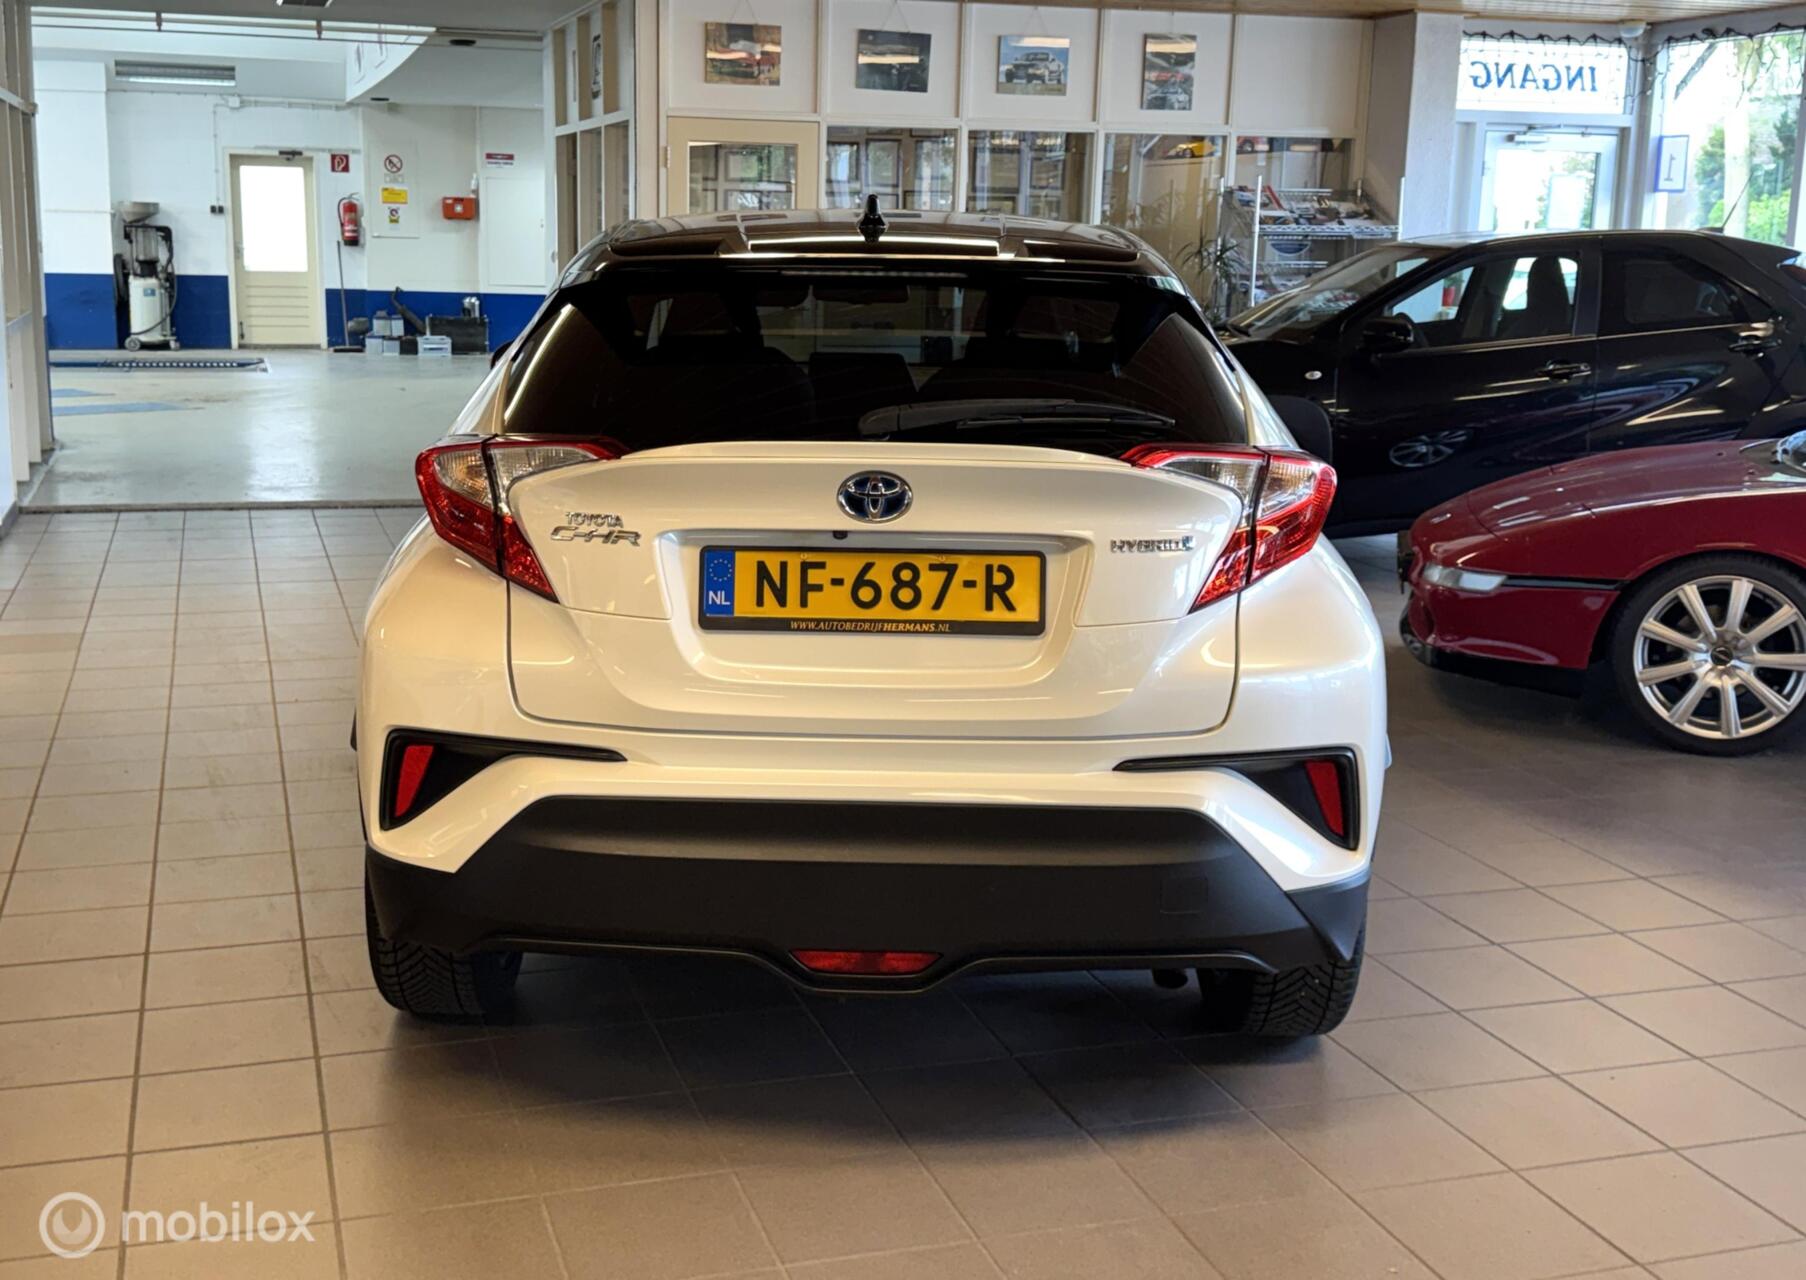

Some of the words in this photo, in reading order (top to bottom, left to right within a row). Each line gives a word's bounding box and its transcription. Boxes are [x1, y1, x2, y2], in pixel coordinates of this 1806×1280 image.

[566, 511, 624, 528] TOYOTA
[550, 525, 642, 547] C-HR
[755, 560, 1018, 613] NF-687-R
[708, 591, 731, 606] NL
[790, 620, 951, 633] WWW.AUTOBEDRIJFHERMANS.NL
